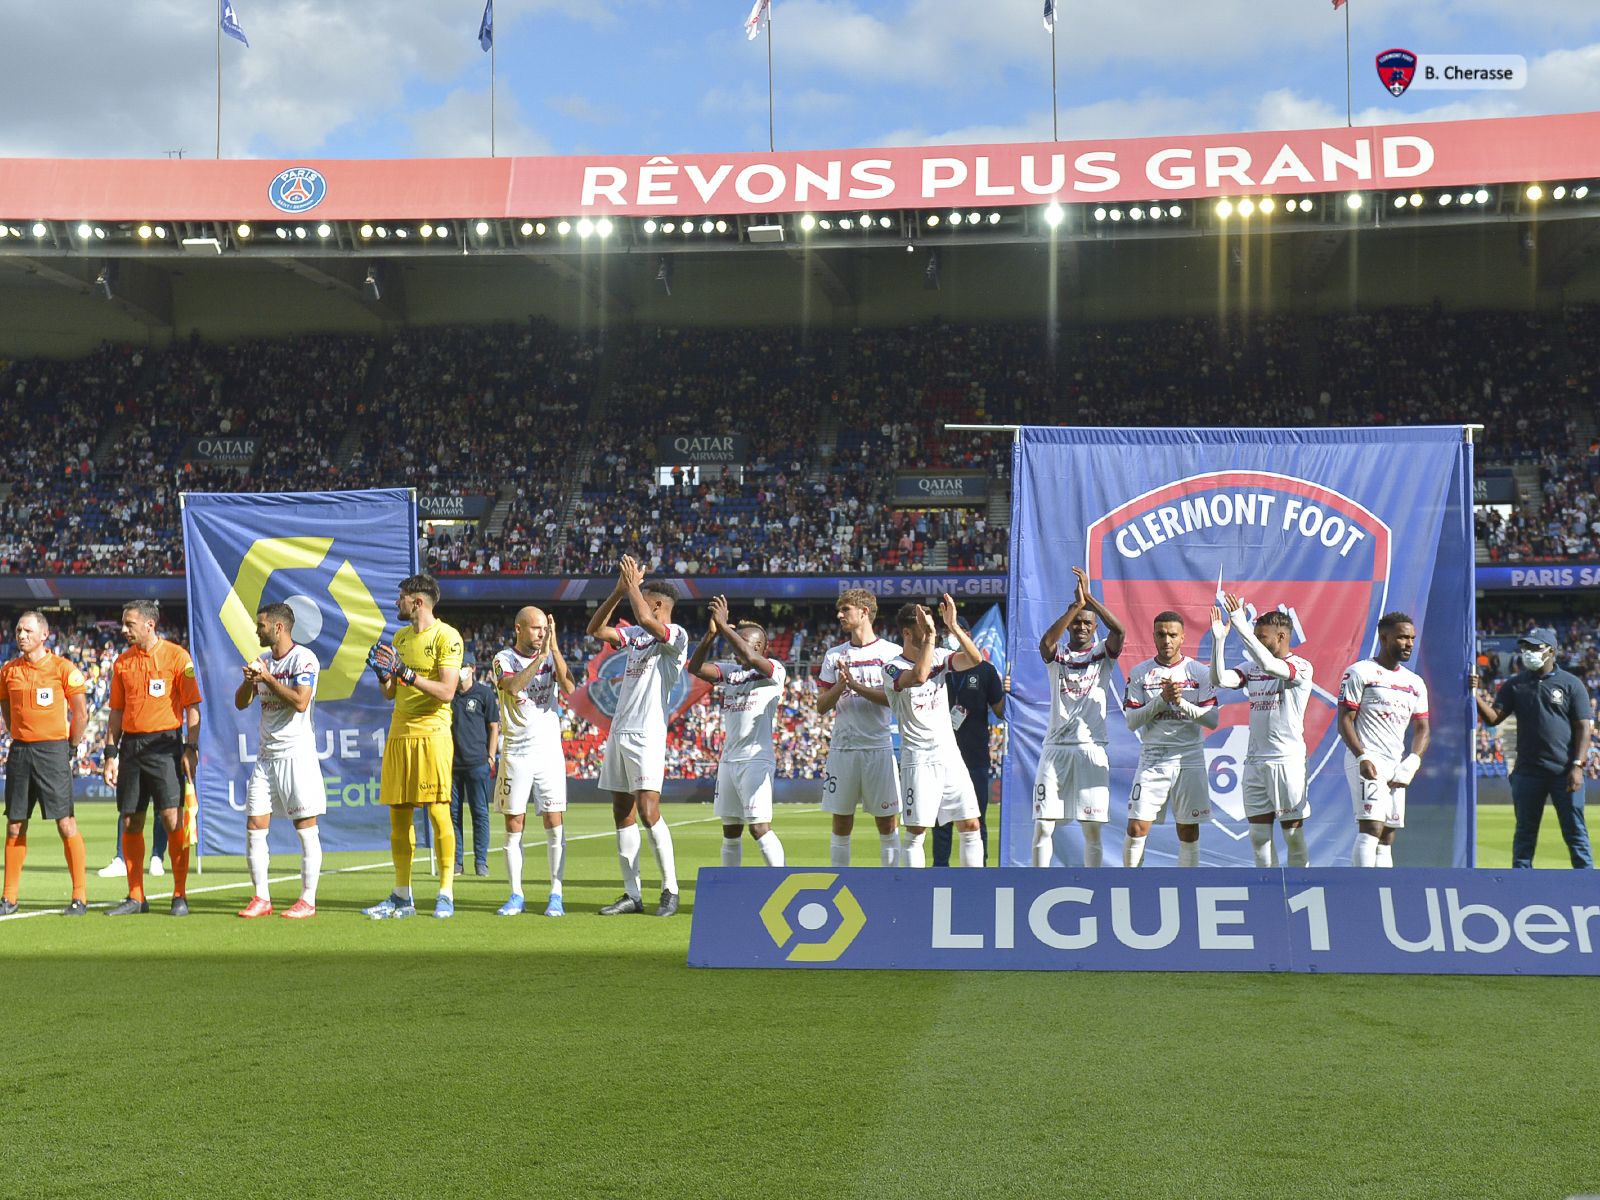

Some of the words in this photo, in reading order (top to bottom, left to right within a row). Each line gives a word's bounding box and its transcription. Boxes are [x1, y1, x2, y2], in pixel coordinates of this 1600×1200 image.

[280, 169, 318, 182] PARIS
[580, 156, 896, 206] RÊVONS
[920, 150, 1121, 199] PLUS
[1144, 135, 1436, 190] GRAND
[197, 440, 255, 457] QATAR
[673, 437, 734, 454] QATAR
[688, 451, 735, 461] AIRWAYS
[918, 478, 963, 492] QATAR
[419, 496, 464, 511] QATAR
[430, 507, 464, 515] AIRWAYS
[1115, 493, 1276, 558] CLERMONT
[1282, 499, 1365, 557] FOOT
[1511, 568, 1574, 586] PARIS
[838, 579, 895, 595] PARIS
[900, 578, 1007, 595] SAINT-GER
[324, 776, 381, 808] Eat
[906, 787, 914, 806] 8
[1360, 781, 1378, 801] 12
[931, 886, 1255, 950] LIGUE
[1287, 886, 1331, 951] 1
[1379, 887, 1600, 954] Uber
